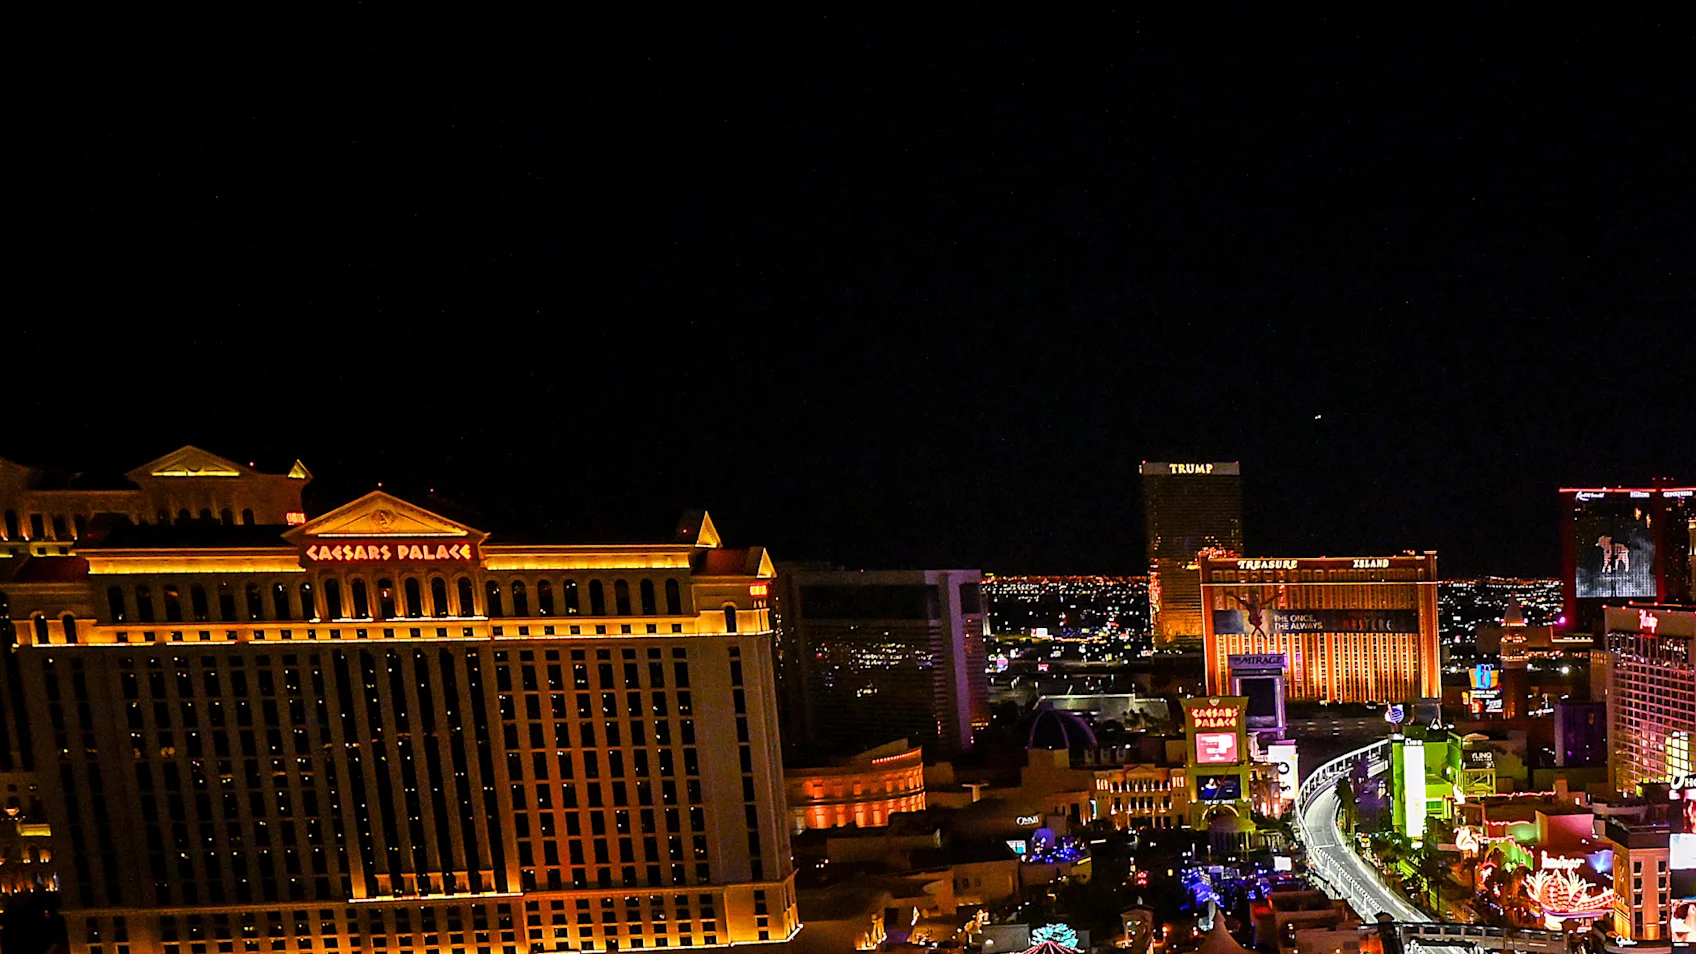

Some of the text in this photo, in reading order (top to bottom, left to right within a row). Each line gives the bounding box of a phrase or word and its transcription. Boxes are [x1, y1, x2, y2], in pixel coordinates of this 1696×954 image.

[1168, 462, 1213, 474] TRUMP
[306, 544, 471, 561] CAESARS PALACE
[1237, 558, 1390, 570] TREASURE ISLAND
[1274, 614, 1289, 623] THE
[1274, 621, 1324, 631] THE ALWAYS
[1242, 655, 1283, 665] MIRAGE
[1191, 708, 1238, 718] CAESARS
[1194, 718, 1237, 728] PALACE
